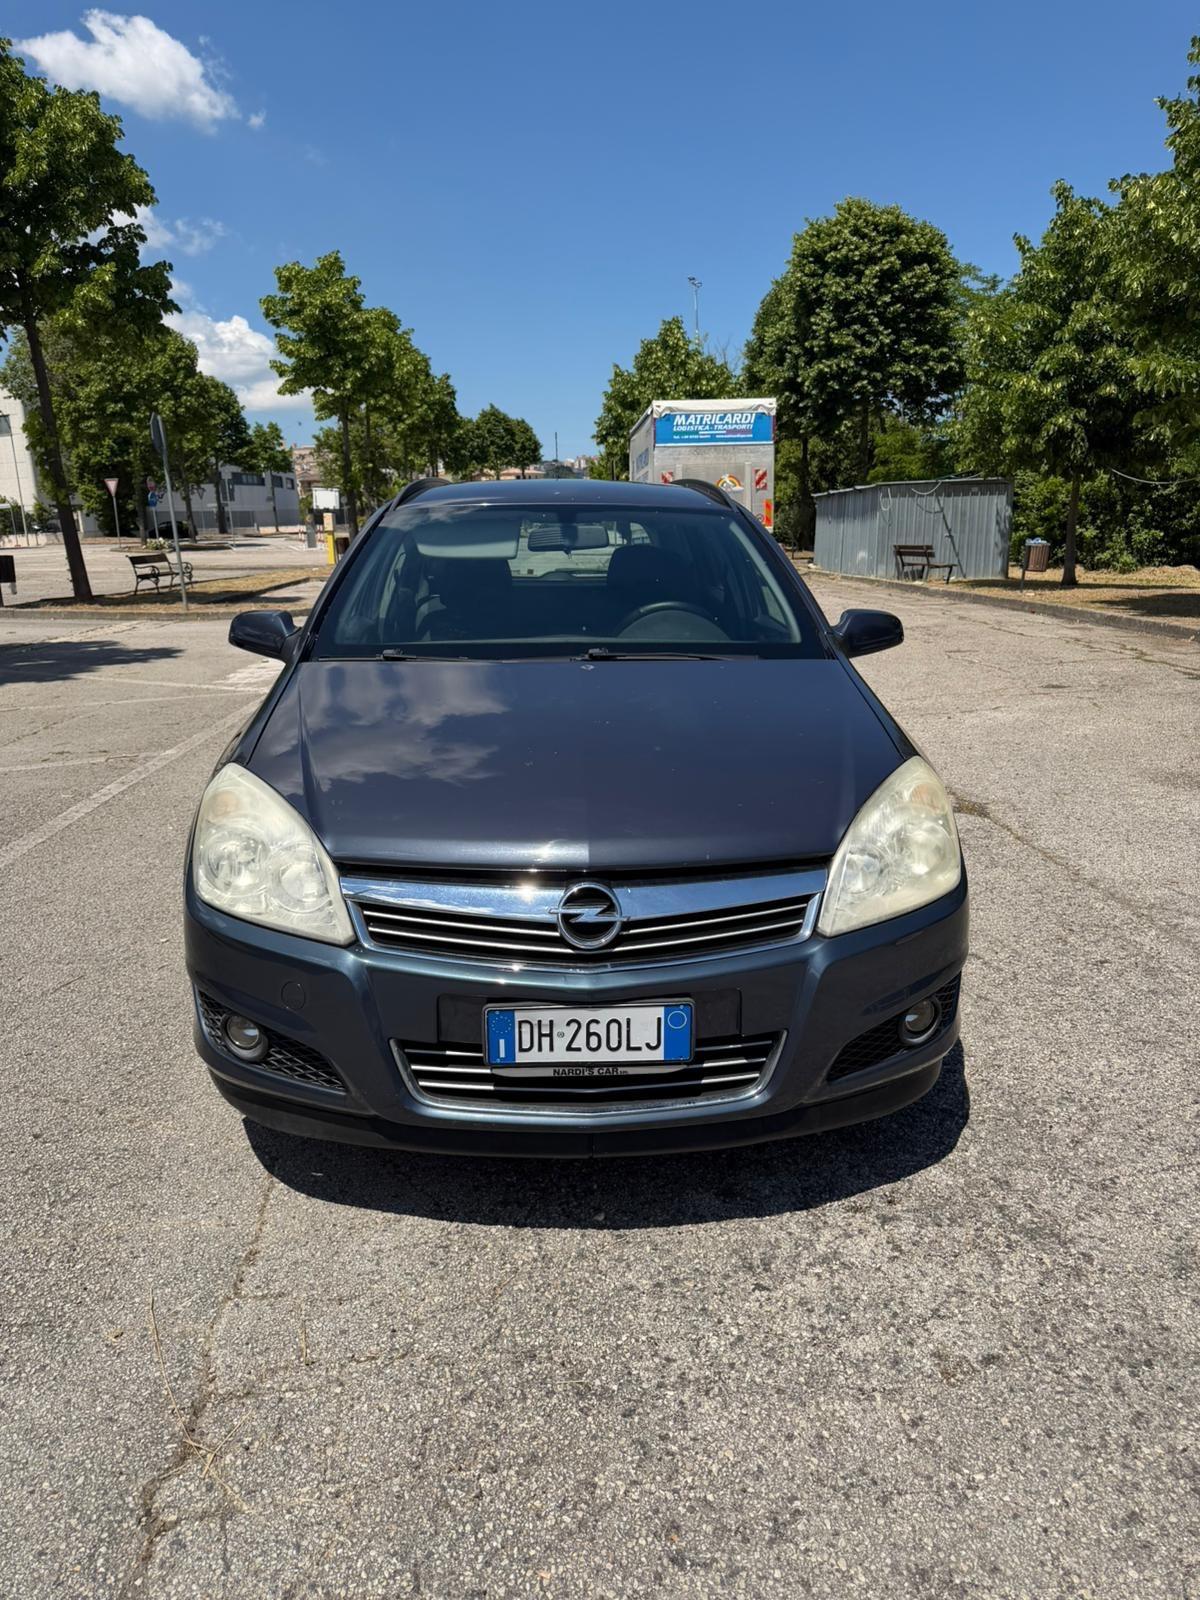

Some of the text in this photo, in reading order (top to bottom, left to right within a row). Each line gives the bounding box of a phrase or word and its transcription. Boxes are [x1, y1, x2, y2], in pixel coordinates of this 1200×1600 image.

[673, 413, 756, 425] MATRICARDI
[518, 1017, 662, 1053] DH 260LJ
[552, 1067, 595, 1076] NARDI'S
[597, 1067, 619, 1075] CAR
